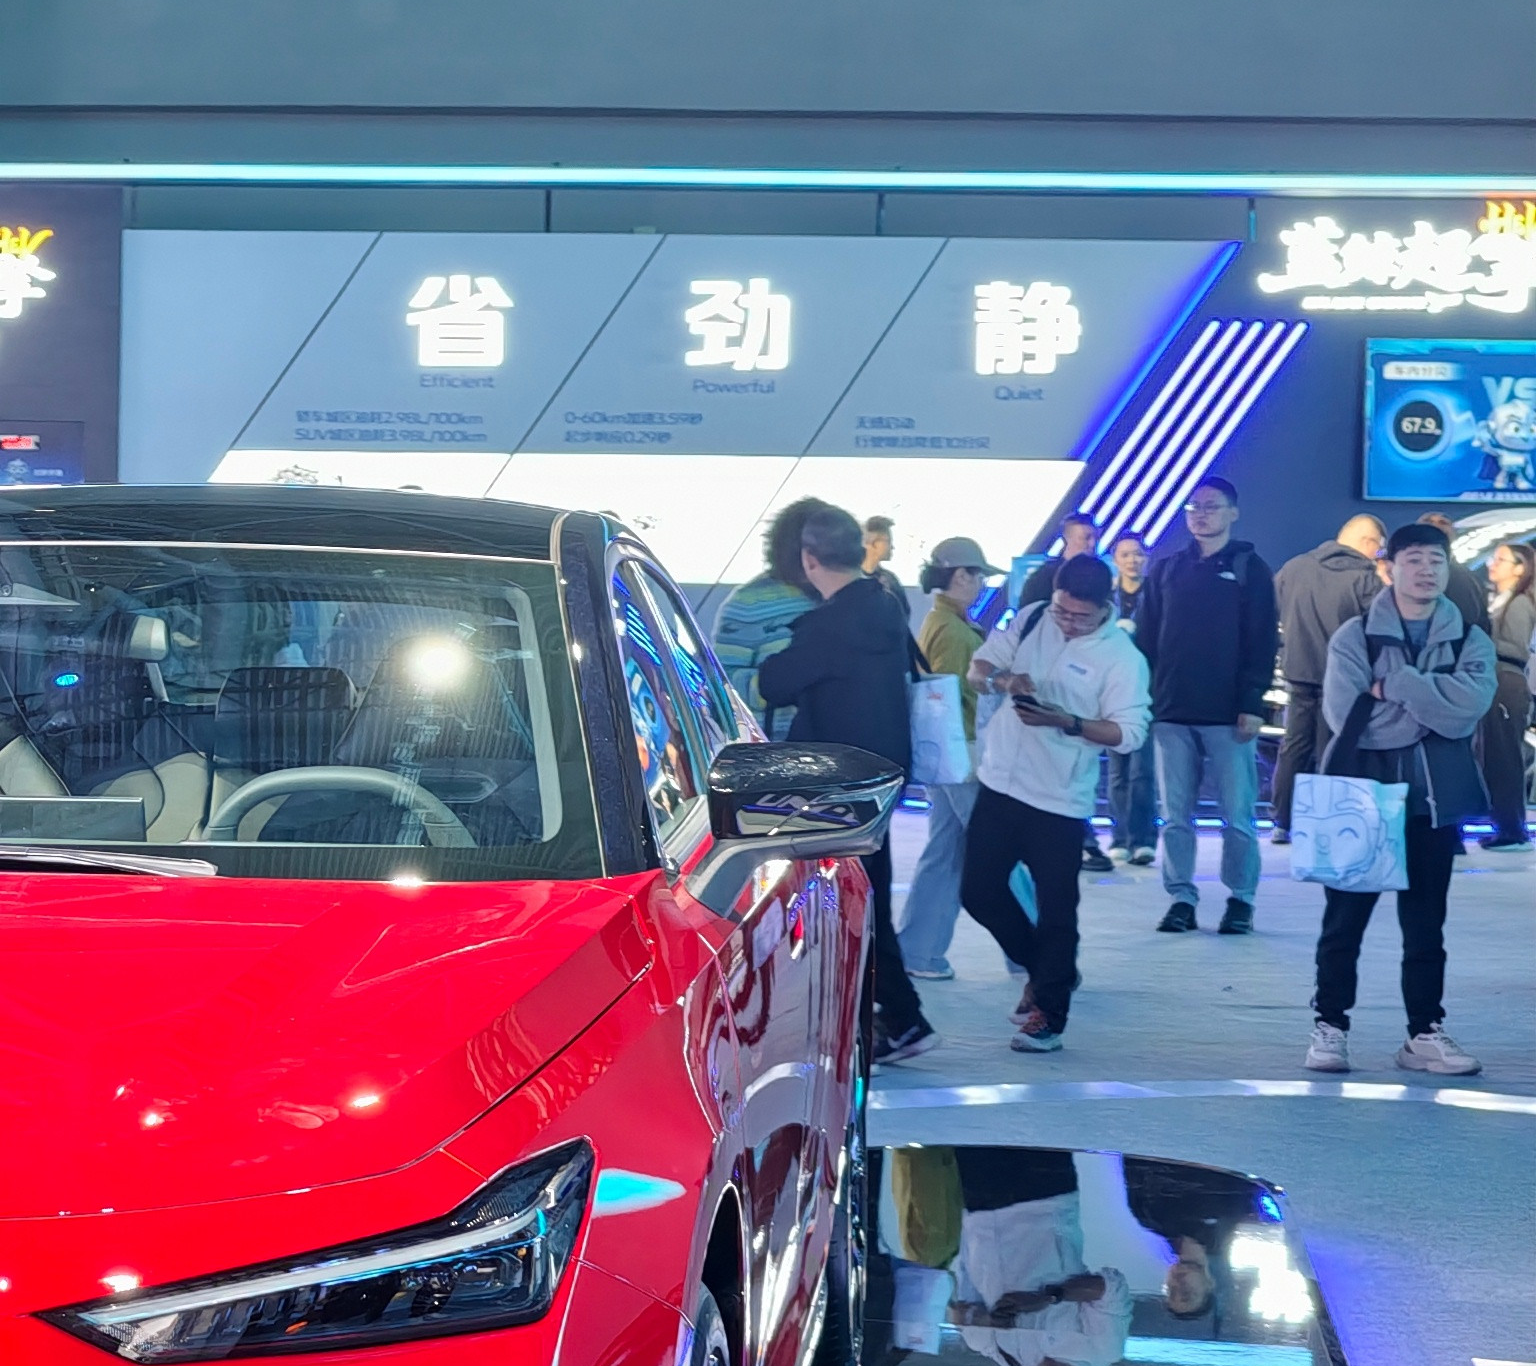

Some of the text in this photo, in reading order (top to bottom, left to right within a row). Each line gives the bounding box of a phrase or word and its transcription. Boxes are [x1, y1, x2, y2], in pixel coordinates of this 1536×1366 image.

[406, 275, 514, 367] 省
[684, 277, 791, 370] 劲
[974, 281, 1082, 375] 静
[420, 374, 495, 388] Efficient
[693, 379, 776, 393] Powerful
[995, 386, 1044, 400] Quiet
